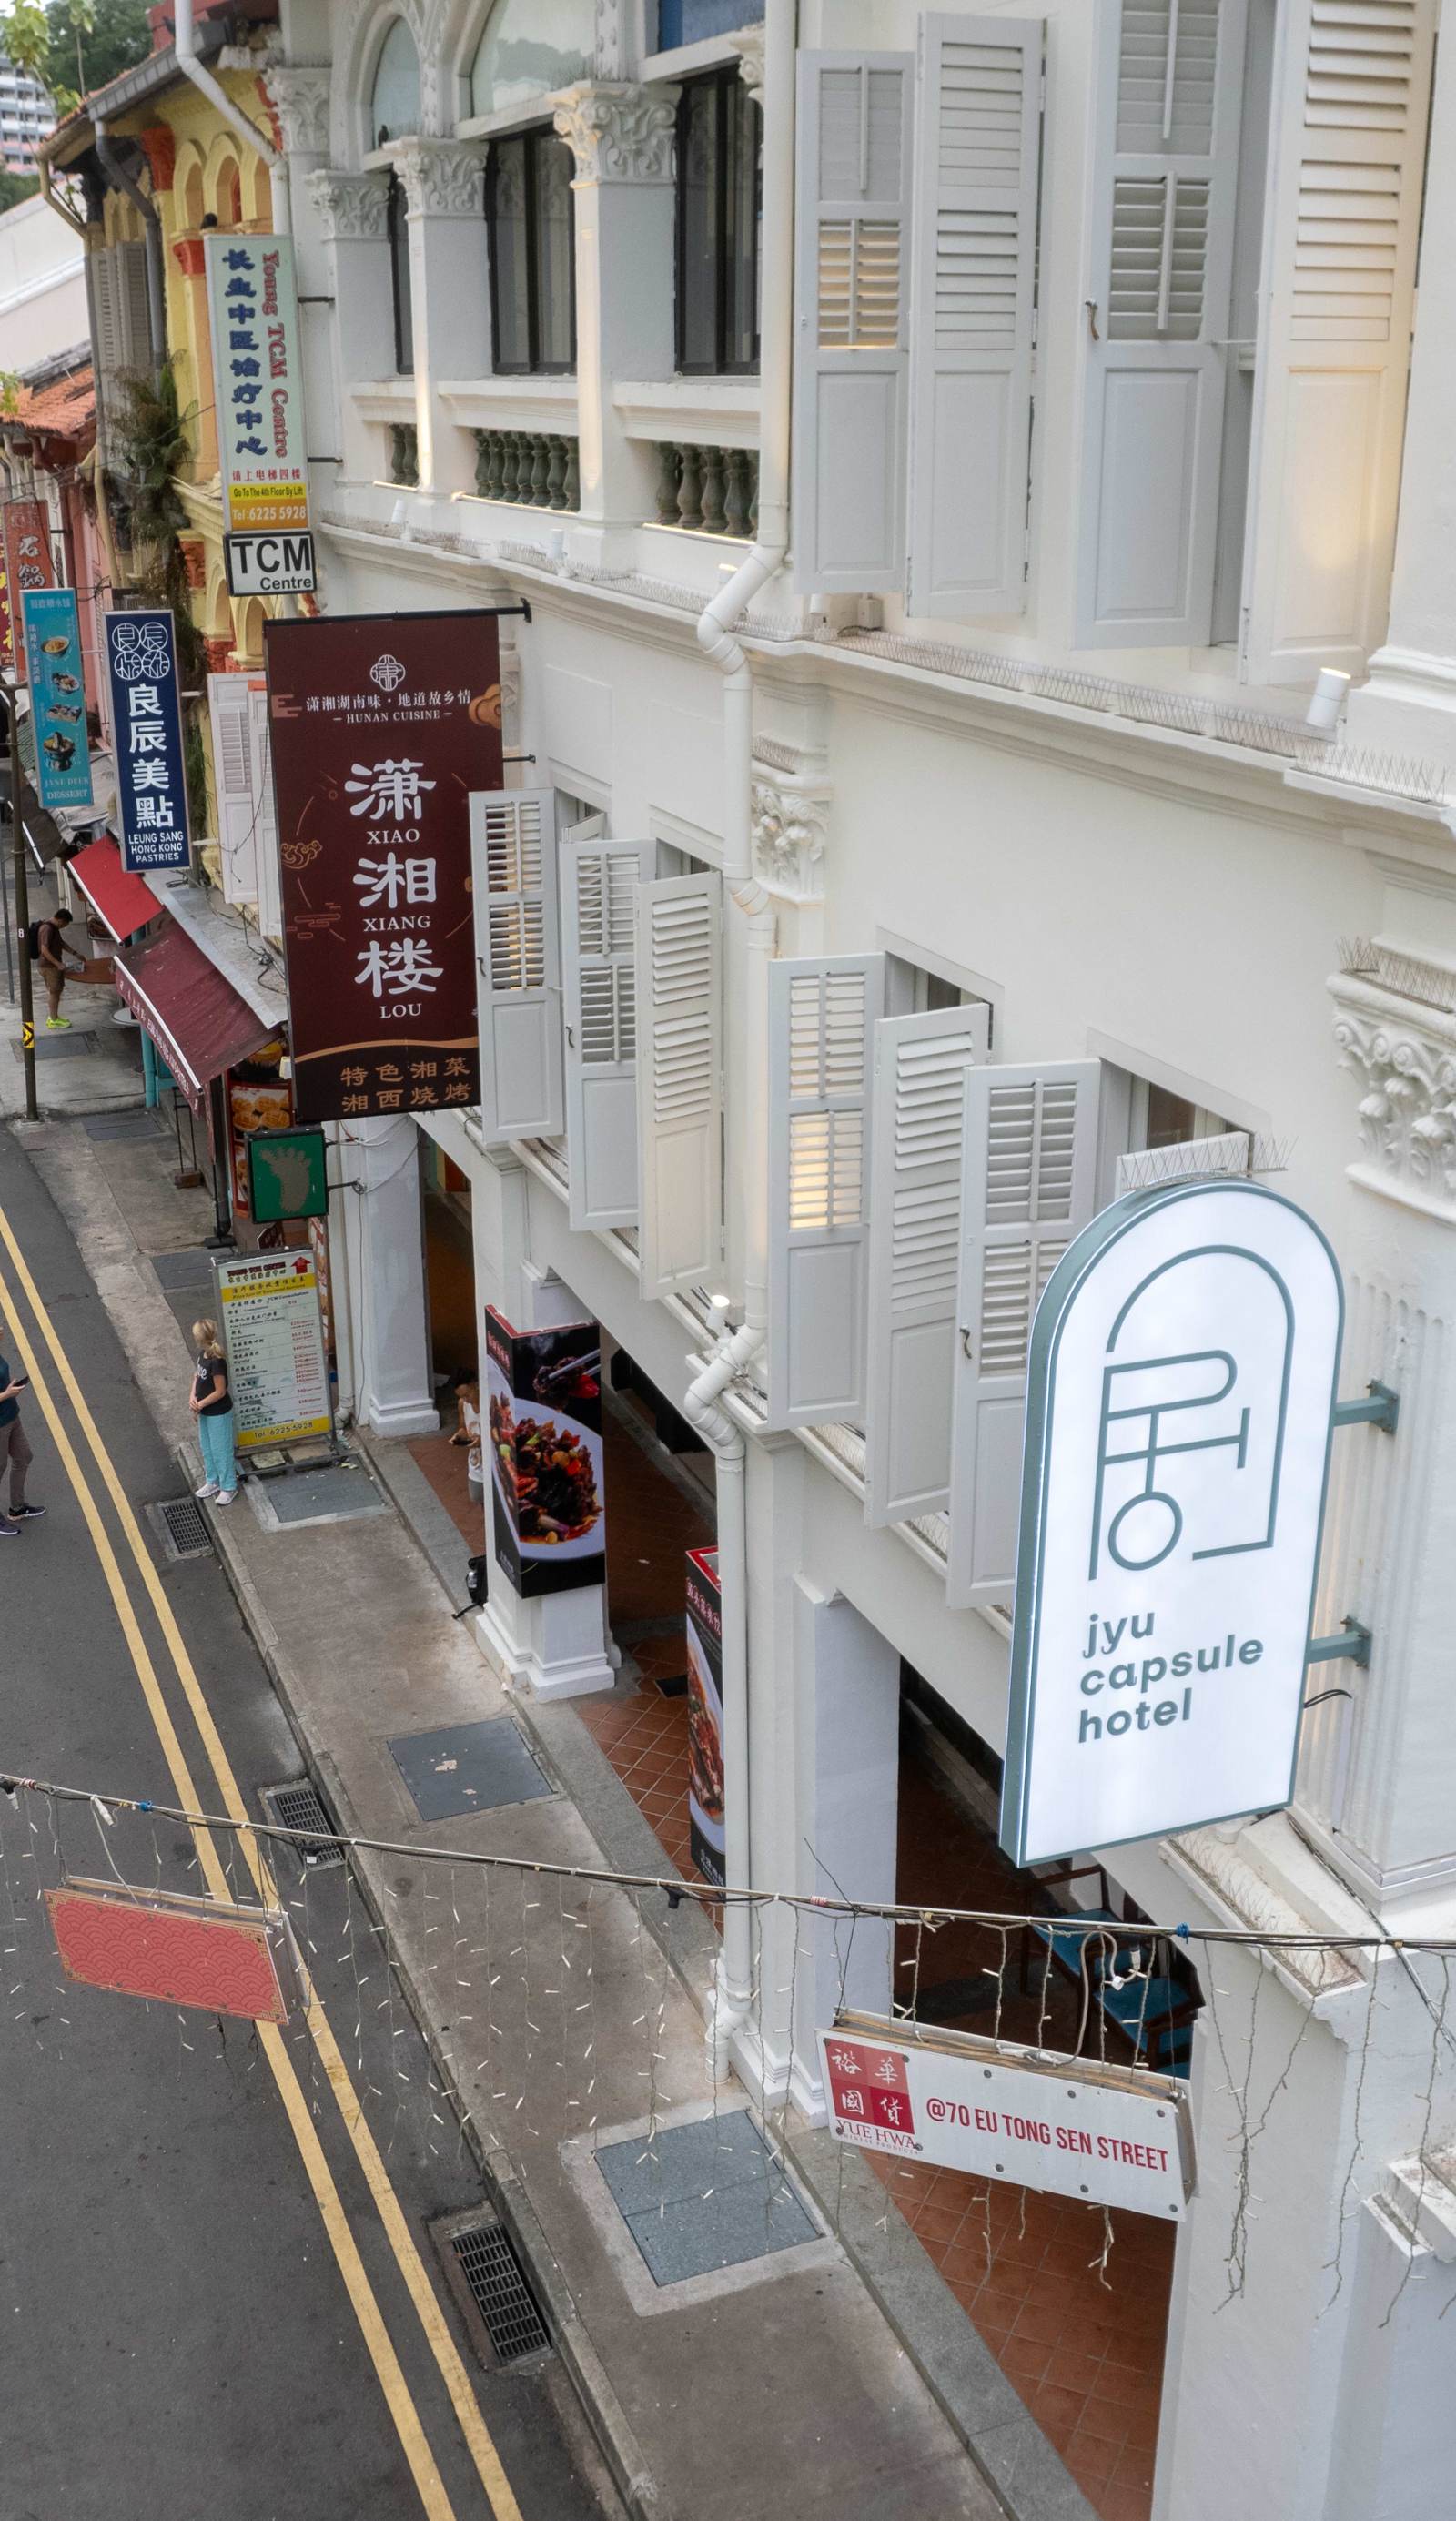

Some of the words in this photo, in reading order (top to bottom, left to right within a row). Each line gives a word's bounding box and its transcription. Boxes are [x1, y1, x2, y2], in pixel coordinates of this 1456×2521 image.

[262, 249, 280, 317] Young
[268, 322, 288, 379] TCM
[271, 388, 289, 459] Centre
[232, 468, 301, 481] 请上电梯四楼
[234, 488, 241, 497] Go
[243, 488, 249, 497] To
[250, 487, 260, 496] The
[261, 487, 270, 496] 4th
[271, 487, 286, 496] Floor
[286, 486, 293, 498] By
[293, 486, 303, 495] Lift
[279, 505, 306, 520] 5928
[231, 537, 311, 573] TCM
[260, 576, 312, 591] Centre
[346, 713, 389, 724] HUNAN
[393, 710, 440, 721] CUISINE
[127, 683, 175, 829] 良辰美點
[47, 789, 88, 800] DESSERT
[128, 833, 157, 845] LEUNG
[159, 831, 183, 843] SANG
[130, 845, 157, 855] HONG
[158, 843, 183, 853] KONG
[367, 828, 420, 845] XIAO
[136, 852, 179, 863] PASTRIES
[352, 852, 437, 908] 湘
[18, 928, 25, 938] 8
[363, 915, 430, 932] XIANG
[354, 938, 443, 997] 楼
[379, 1003, 421, 1019] LOU
[340, 1057, 470, 1087] 特色湘菜
[342, 1082, 472, 1113] 湘西烧烤
[1083, 1612, 1155, 1659] jyu
[1080, 1634, 1264, 1696] capsule
[1078, 1687, 1192, 1744] hotel
[842, 2090, 903, 2126] 國貨
[837, 2120, 873, 2140] YUE
[874, 2129, 916, 2149] HWA
[926, 2098, 970, 2126] @70
[975, 2108, 998, 2133] EU
[1002, 2113, 1051, 2145] TONG
[1056, 2126, 1092, 2155] SEN
[1097, 2136, 1168, 2172] STREET
